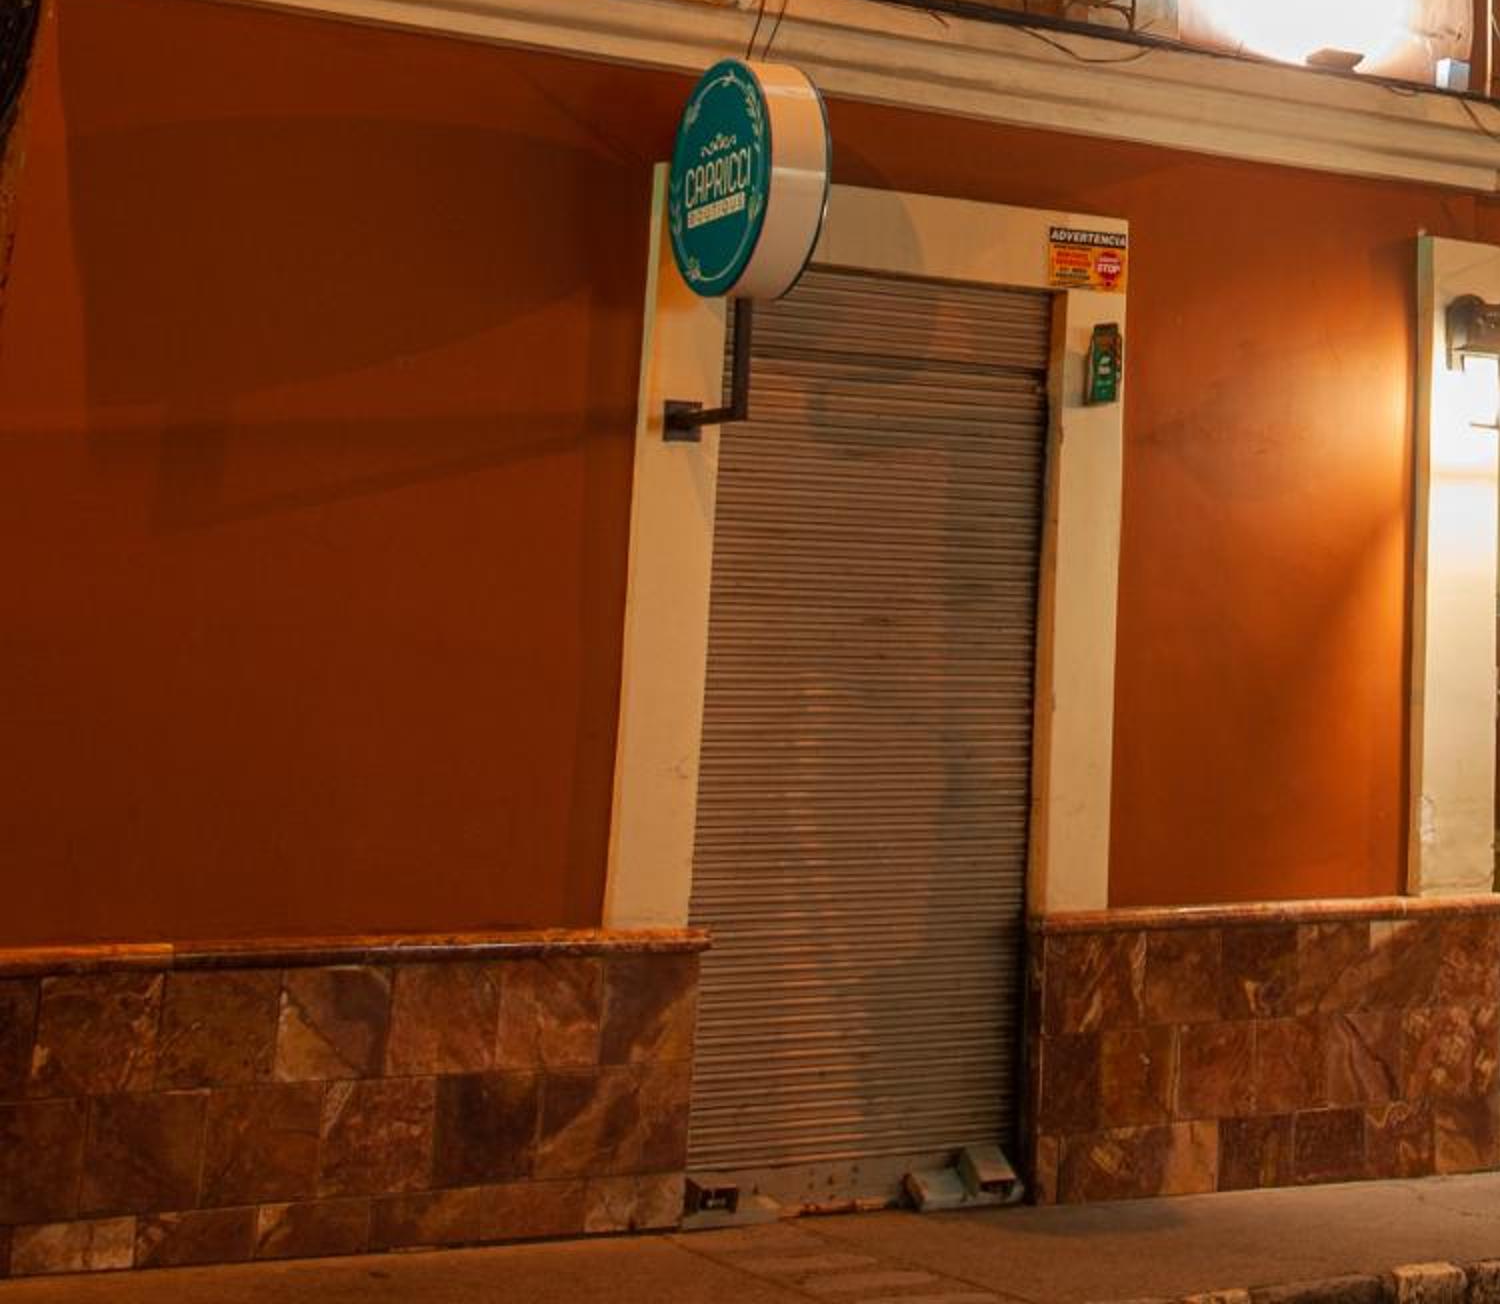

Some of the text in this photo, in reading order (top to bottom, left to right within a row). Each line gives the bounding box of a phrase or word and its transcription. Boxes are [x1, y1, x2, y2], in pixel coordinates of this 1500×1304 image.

[685, 146, 751, 208] CAPRICCI
[1051, 229, 1126, 247] ADVERTENCIA
[1097, 263, 1121, 274] STOP
